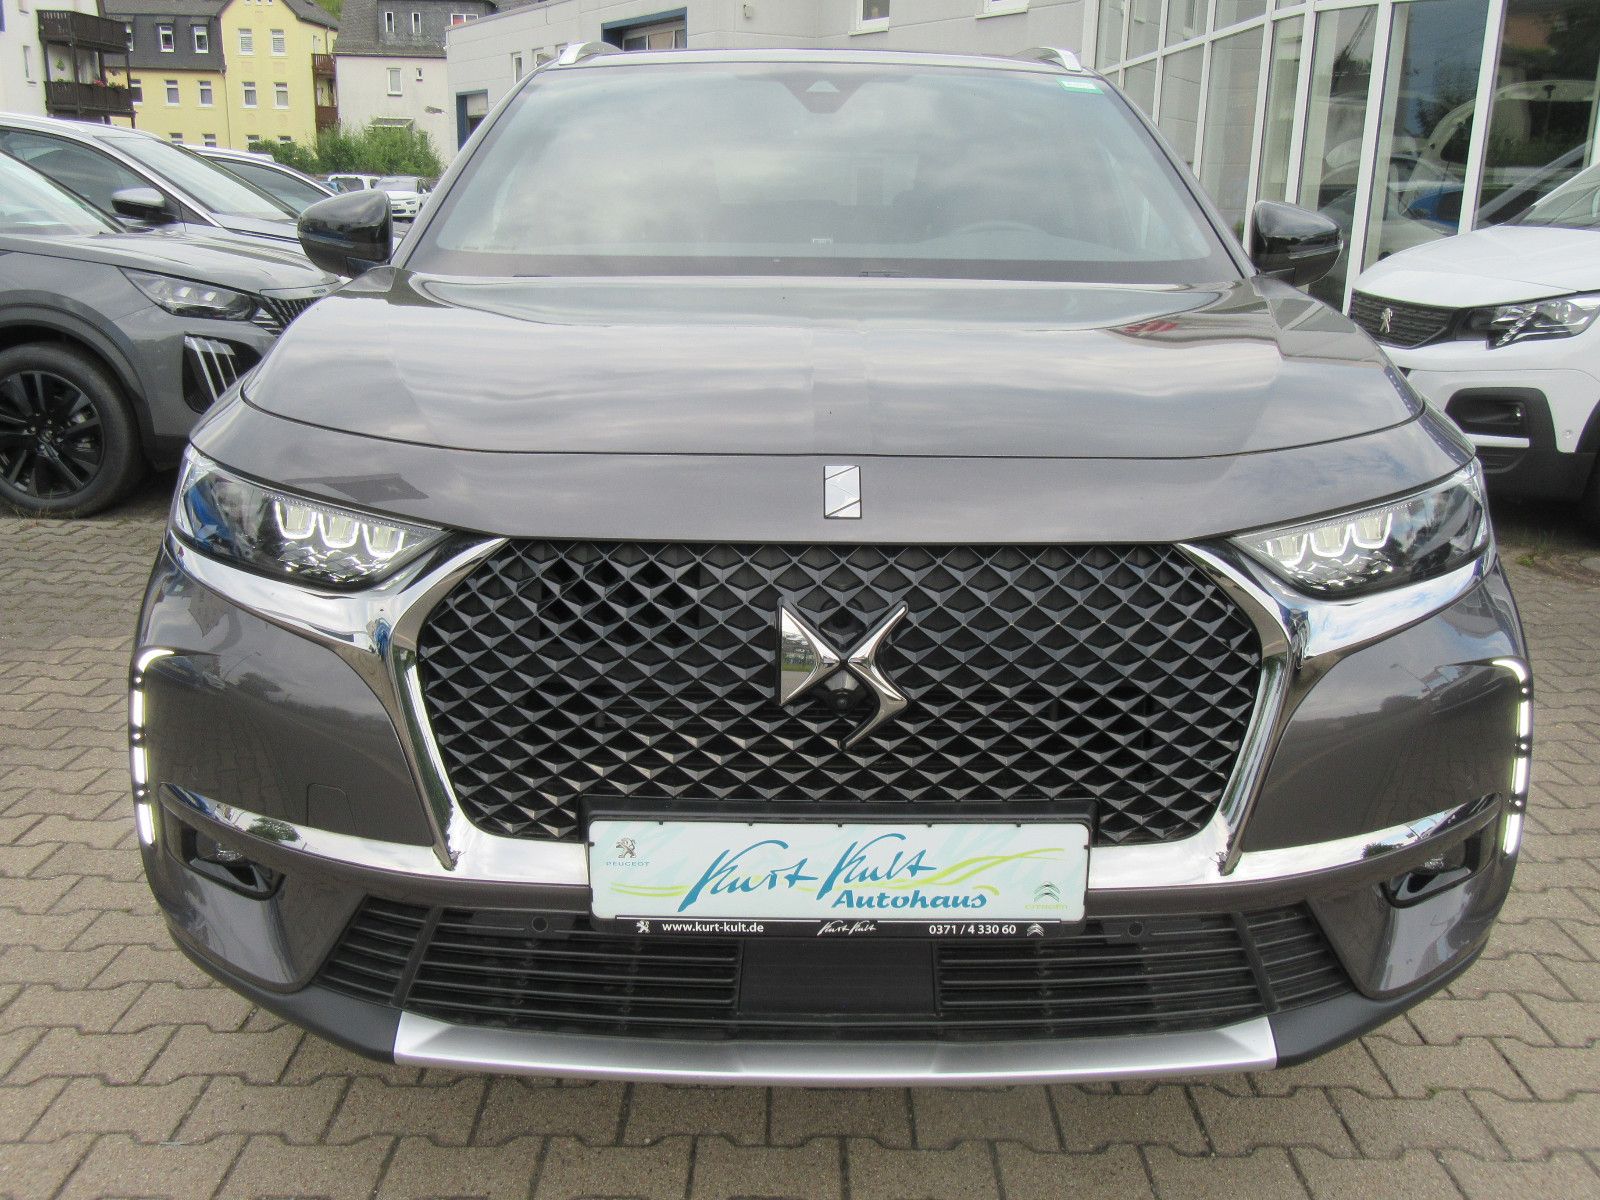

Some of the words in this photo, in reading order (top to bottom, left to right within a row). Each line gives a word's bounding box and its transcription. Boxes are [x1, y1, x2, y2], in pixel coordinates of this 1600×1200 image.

[677, 839, 819, 913] Kurt
[816, 833, 937, 901] Kult
[831, 889, 987, 909] Autohaus
[662, 922, 764, 933] www.kurt-kult.de
[929, 924, 957, 935] 0371
[977, 924, 1000, 935] 330
[1001, 924, 1017, 935] 60
